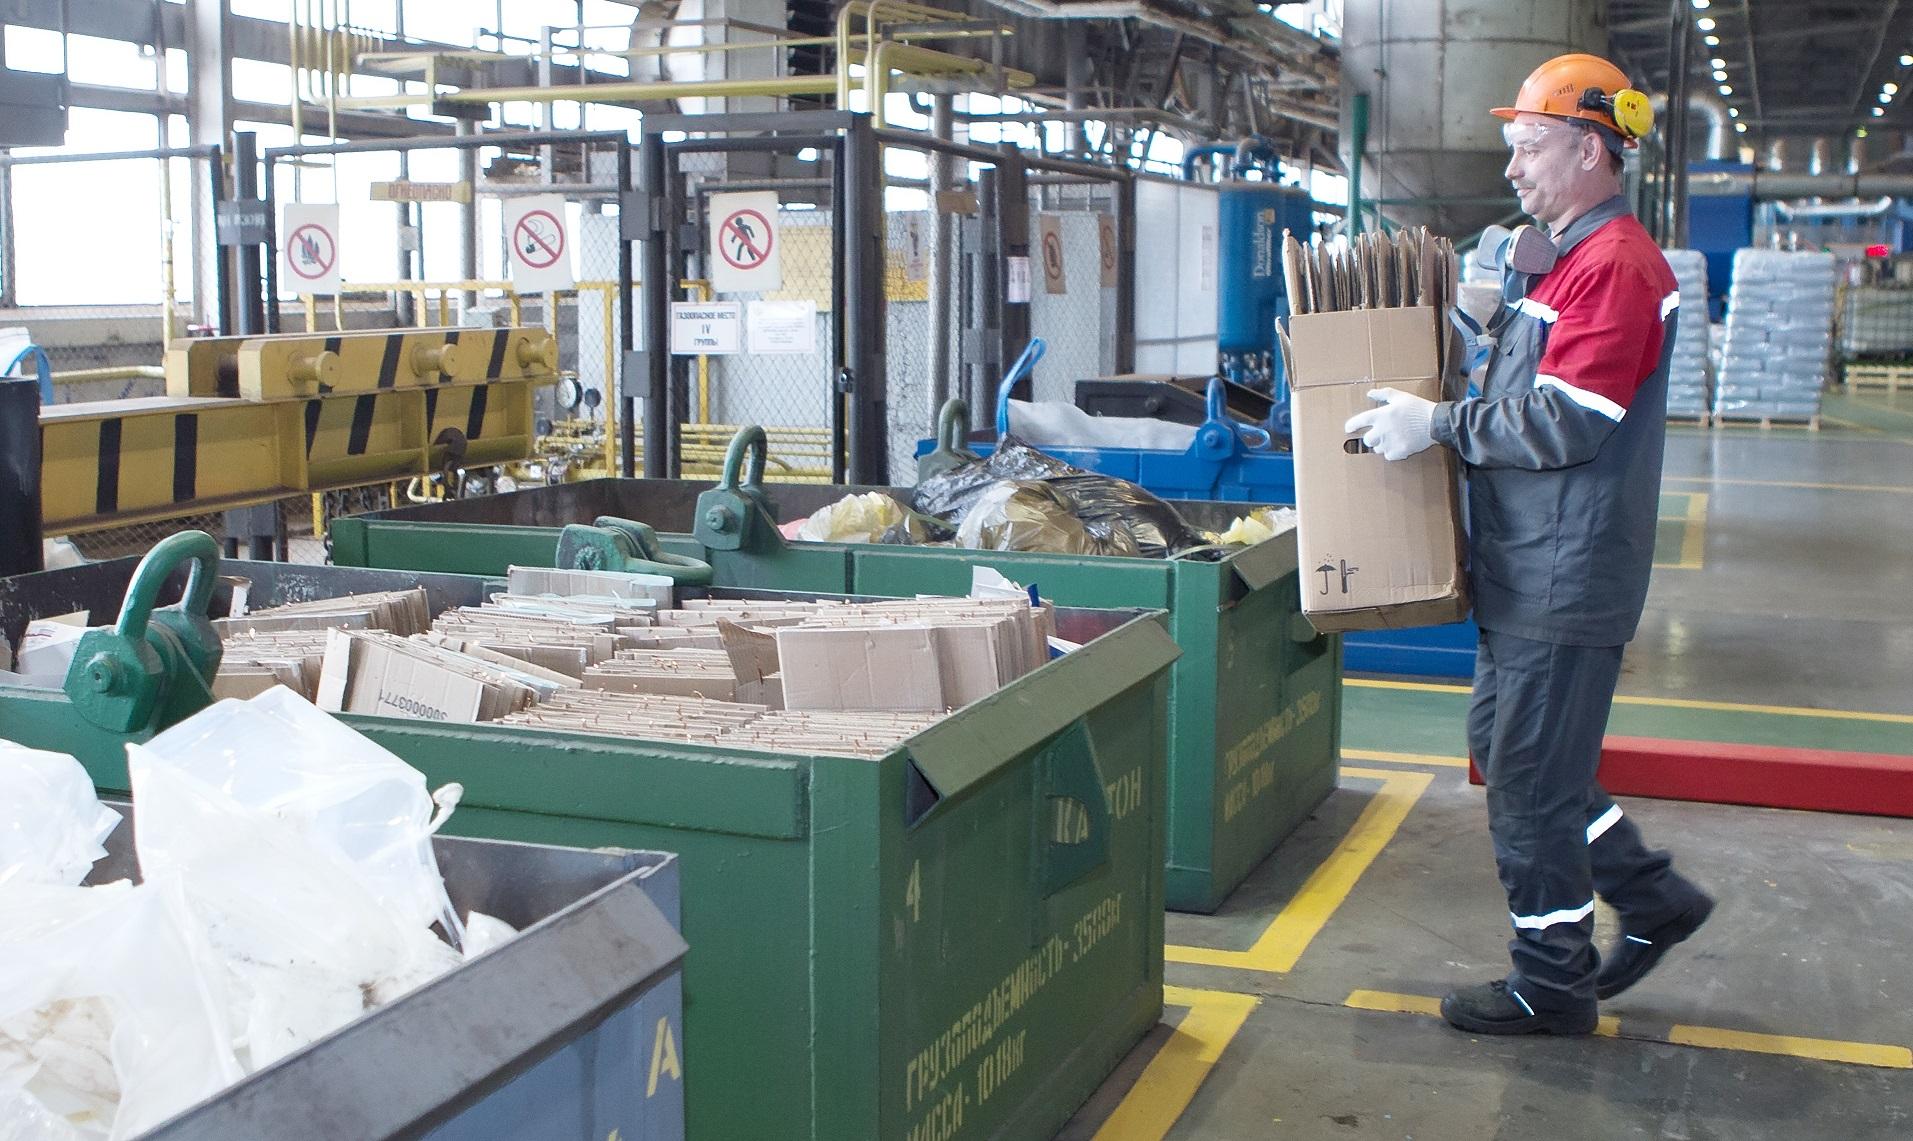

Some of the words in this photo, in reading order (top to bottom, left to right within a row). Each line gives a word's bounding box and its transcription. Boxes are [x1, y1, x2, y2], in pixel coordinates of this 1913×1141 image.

[1252, 211, 1266, 277] Donaldson
[701, 323, 711, 335] IV
[905, 858, 921, 922] 4
